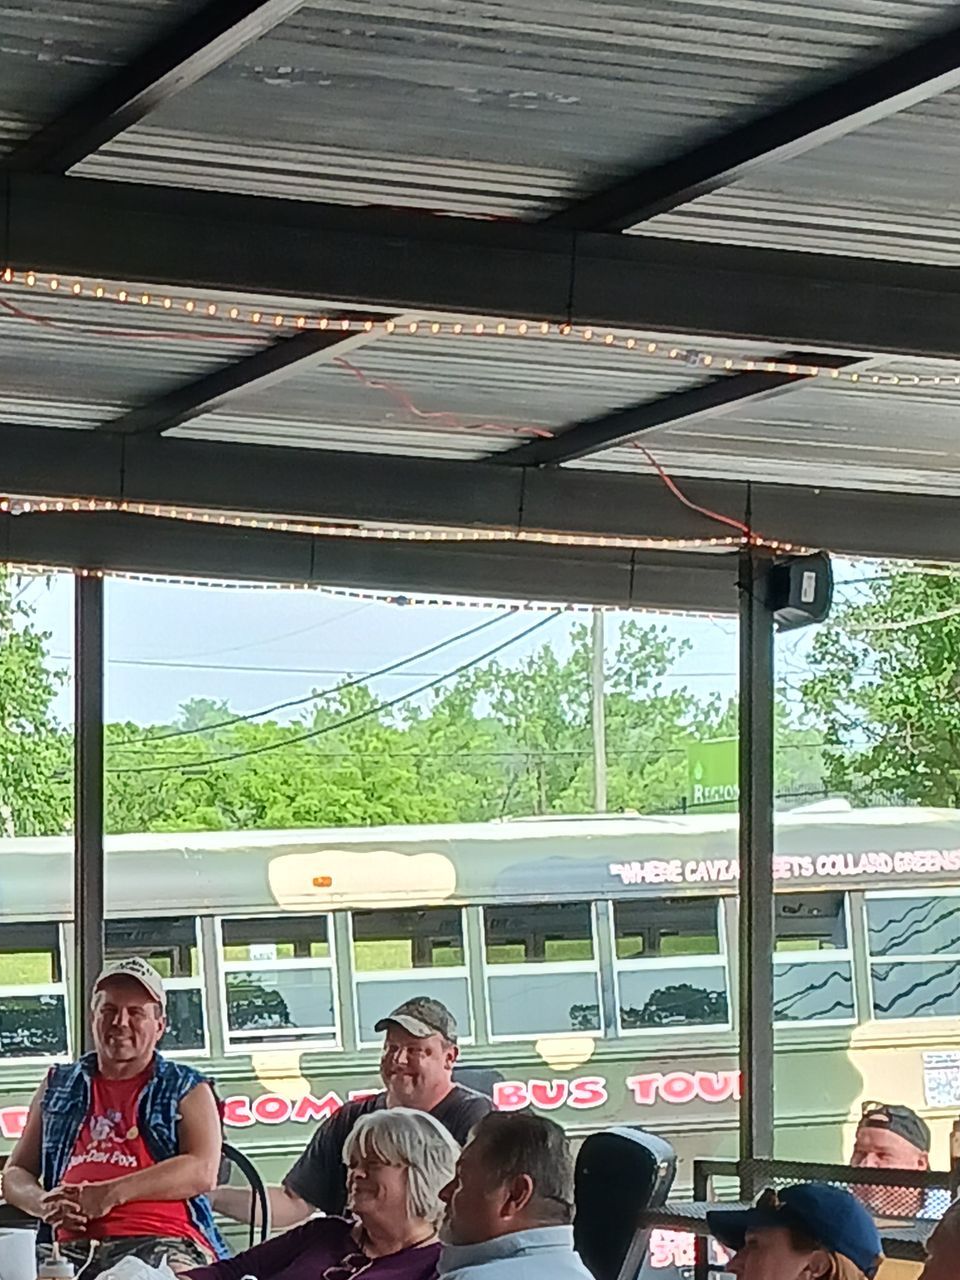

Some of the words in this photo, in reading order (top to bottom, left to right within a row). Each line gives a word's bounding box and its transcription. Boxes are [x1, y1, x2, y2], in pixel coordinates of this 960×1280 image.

[685, 859, 740, 882] CAVIA
[816, 852, 893, 876] COLLARD
[223, 1090, 386, 1127] COM
[493, 1077, 607, 1111] BUS
[626, 1071, 742, 1105] TOU
